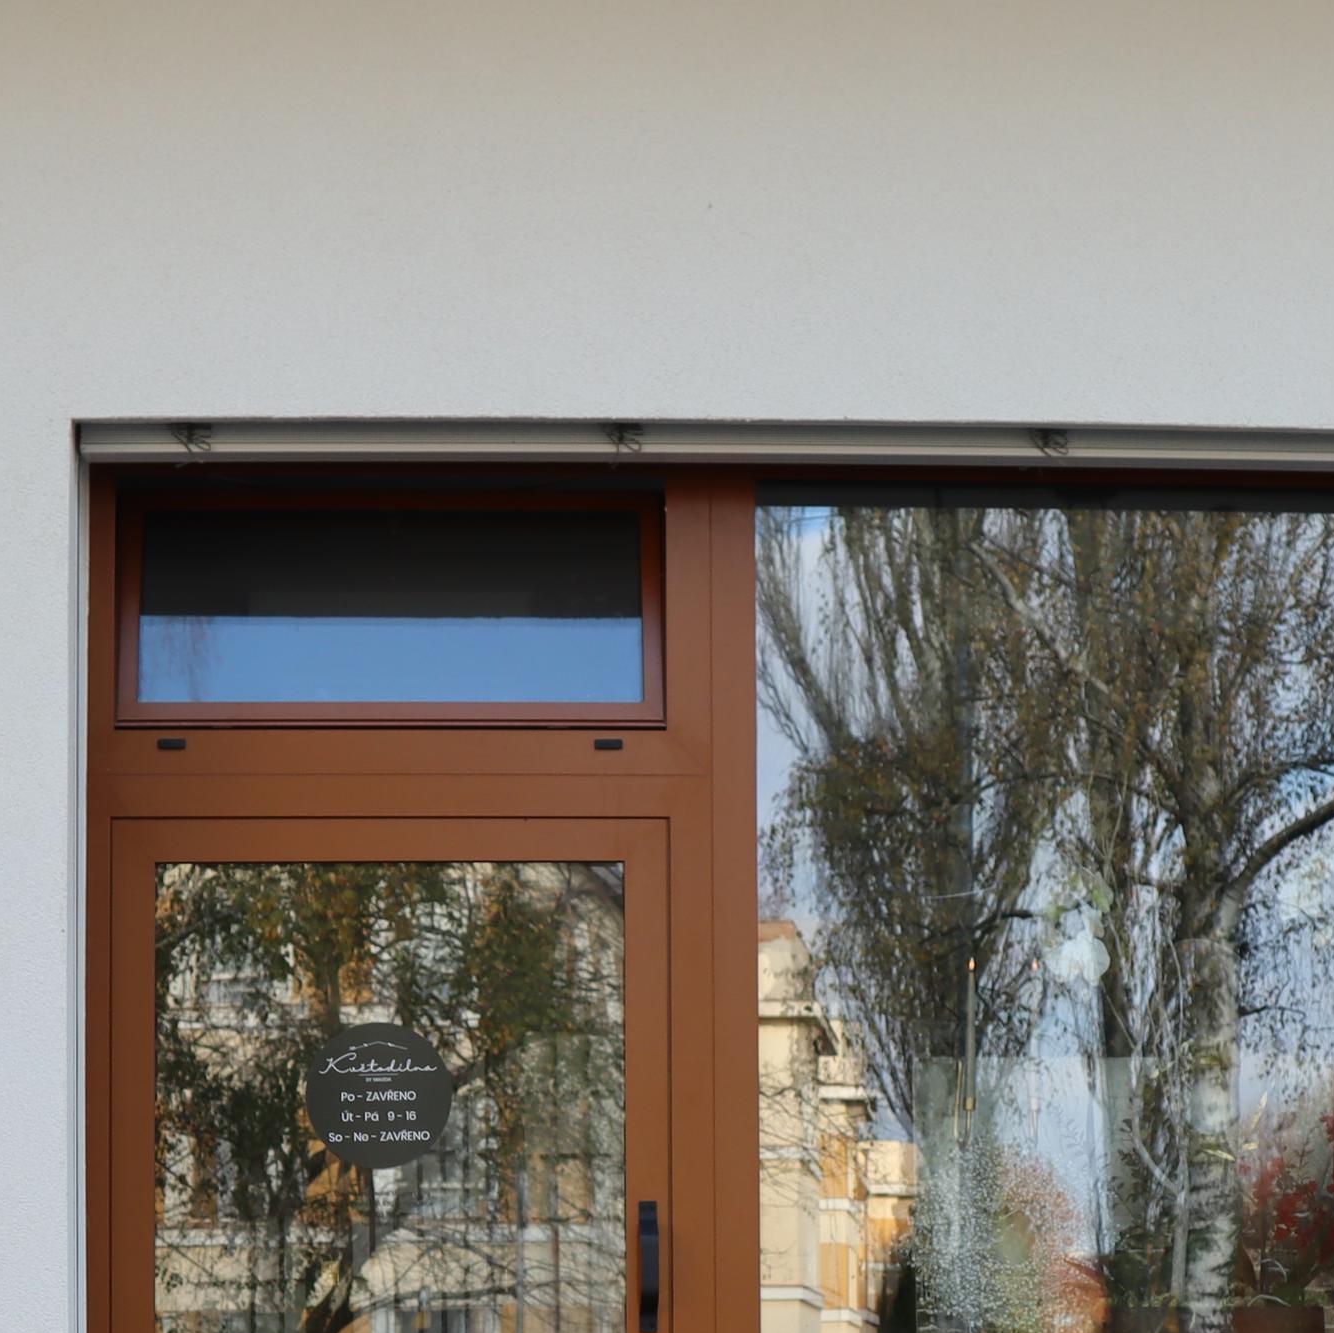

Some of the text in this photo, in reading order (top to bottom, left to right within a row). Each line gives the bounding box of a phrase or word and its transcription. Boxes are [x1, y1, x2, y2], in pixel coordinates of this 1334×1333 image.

[340, 1091, 355, 1102] Po
[365, 1090, 417, 1102] ZAVŘENO
[341, 1110, 354, 1122] Út
[364, 1110, 380, 1122] Pá
[387, 1110, 395, 1121] 9
[405, 1110, 417, 1121] 16
[328, 1132, 343, 1143] So
[353, 1131, 369, 1142] Ne
[379, 1130, 431, 1142] ZAVŘENO
